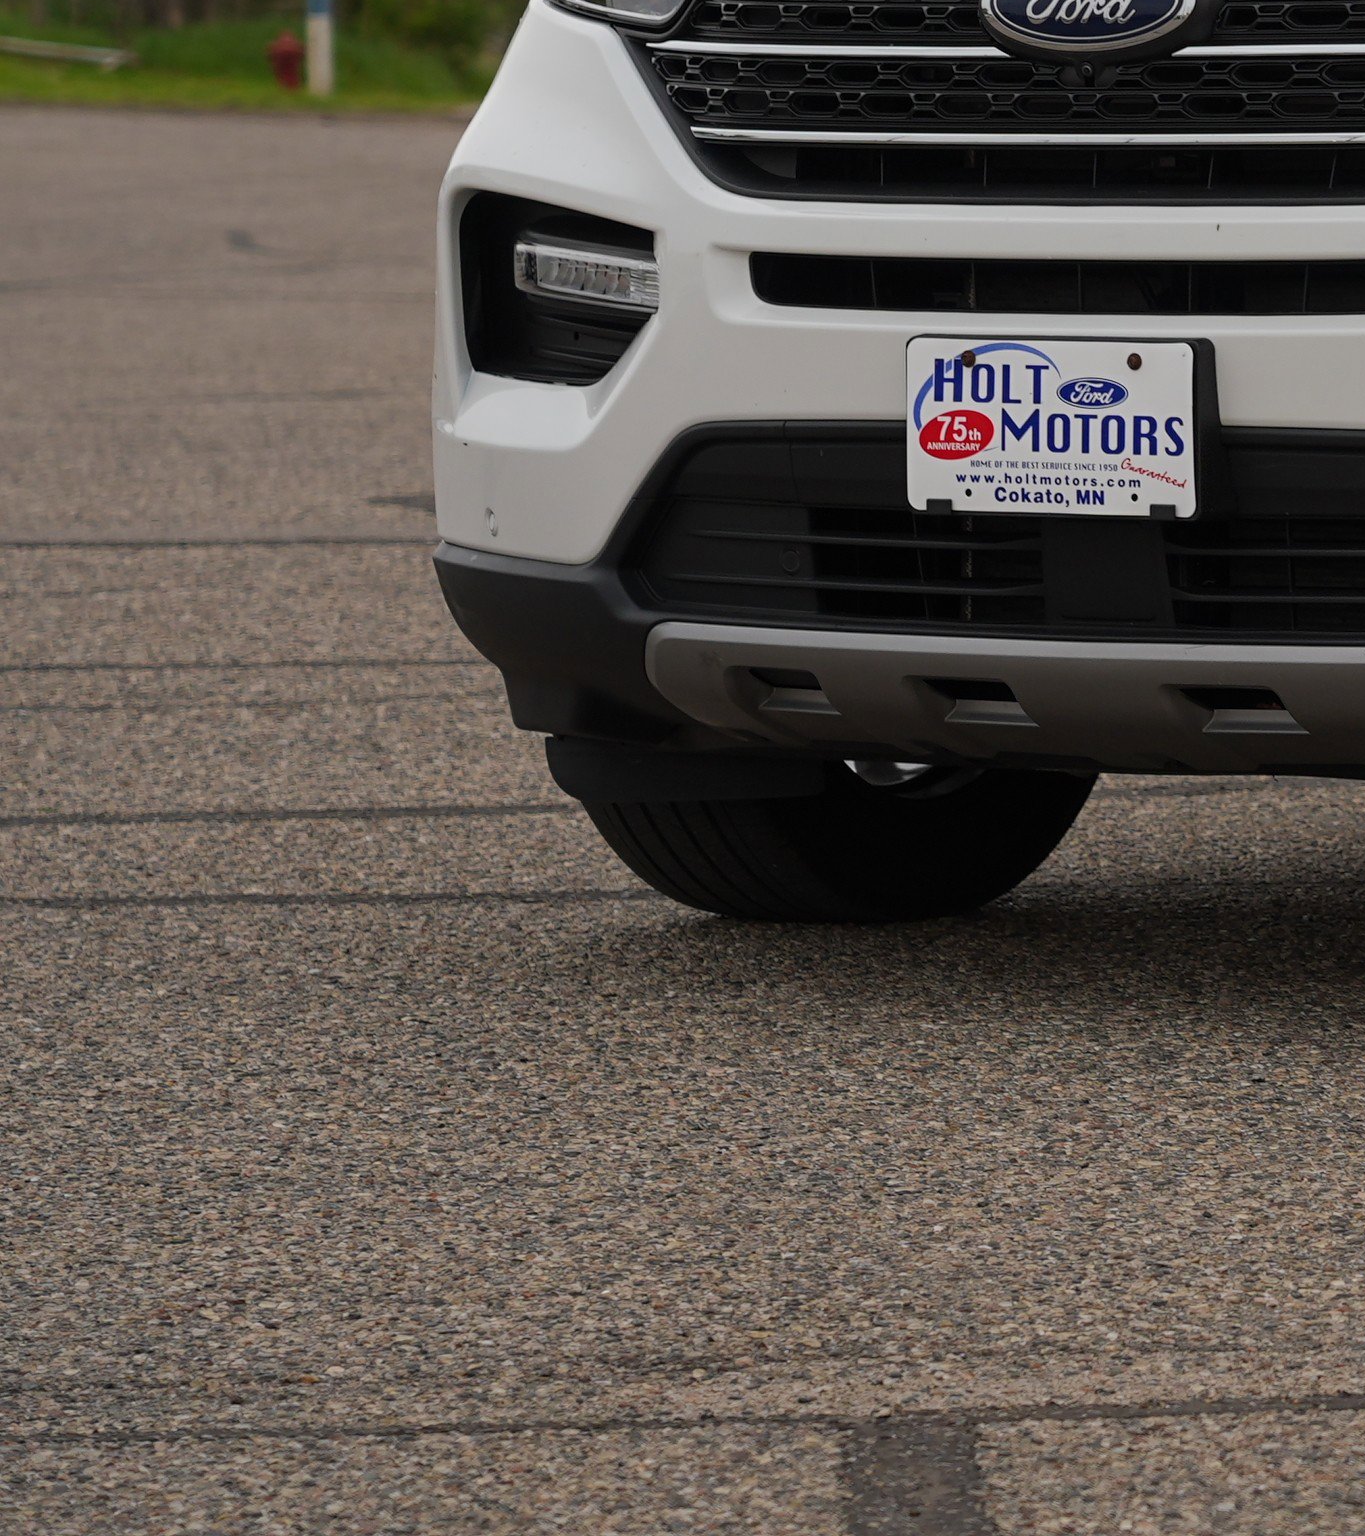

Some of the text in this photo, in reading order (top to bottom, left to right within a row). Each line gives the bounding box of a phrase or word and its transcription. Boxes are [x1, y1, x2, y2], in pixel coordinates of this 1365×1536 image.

[934, 358, 1050, 404] HOLT
[1069, 381, 1114, 404] Ford
[937, 416, 982, 442] 75th
[1001, 408, 1185, 457] MOTORS
[927, 442, 980, 452] ANNIVERSARY
[970, 460, 1118, 472] HOME OF THE BEST SERVICE SINCE 1950
[1121, 457, 1187, 489] Guaranteed
[956, 473, 1141, 488] www.holtmotors.com
[994, 486, 1105, 507] Cokato, MN
